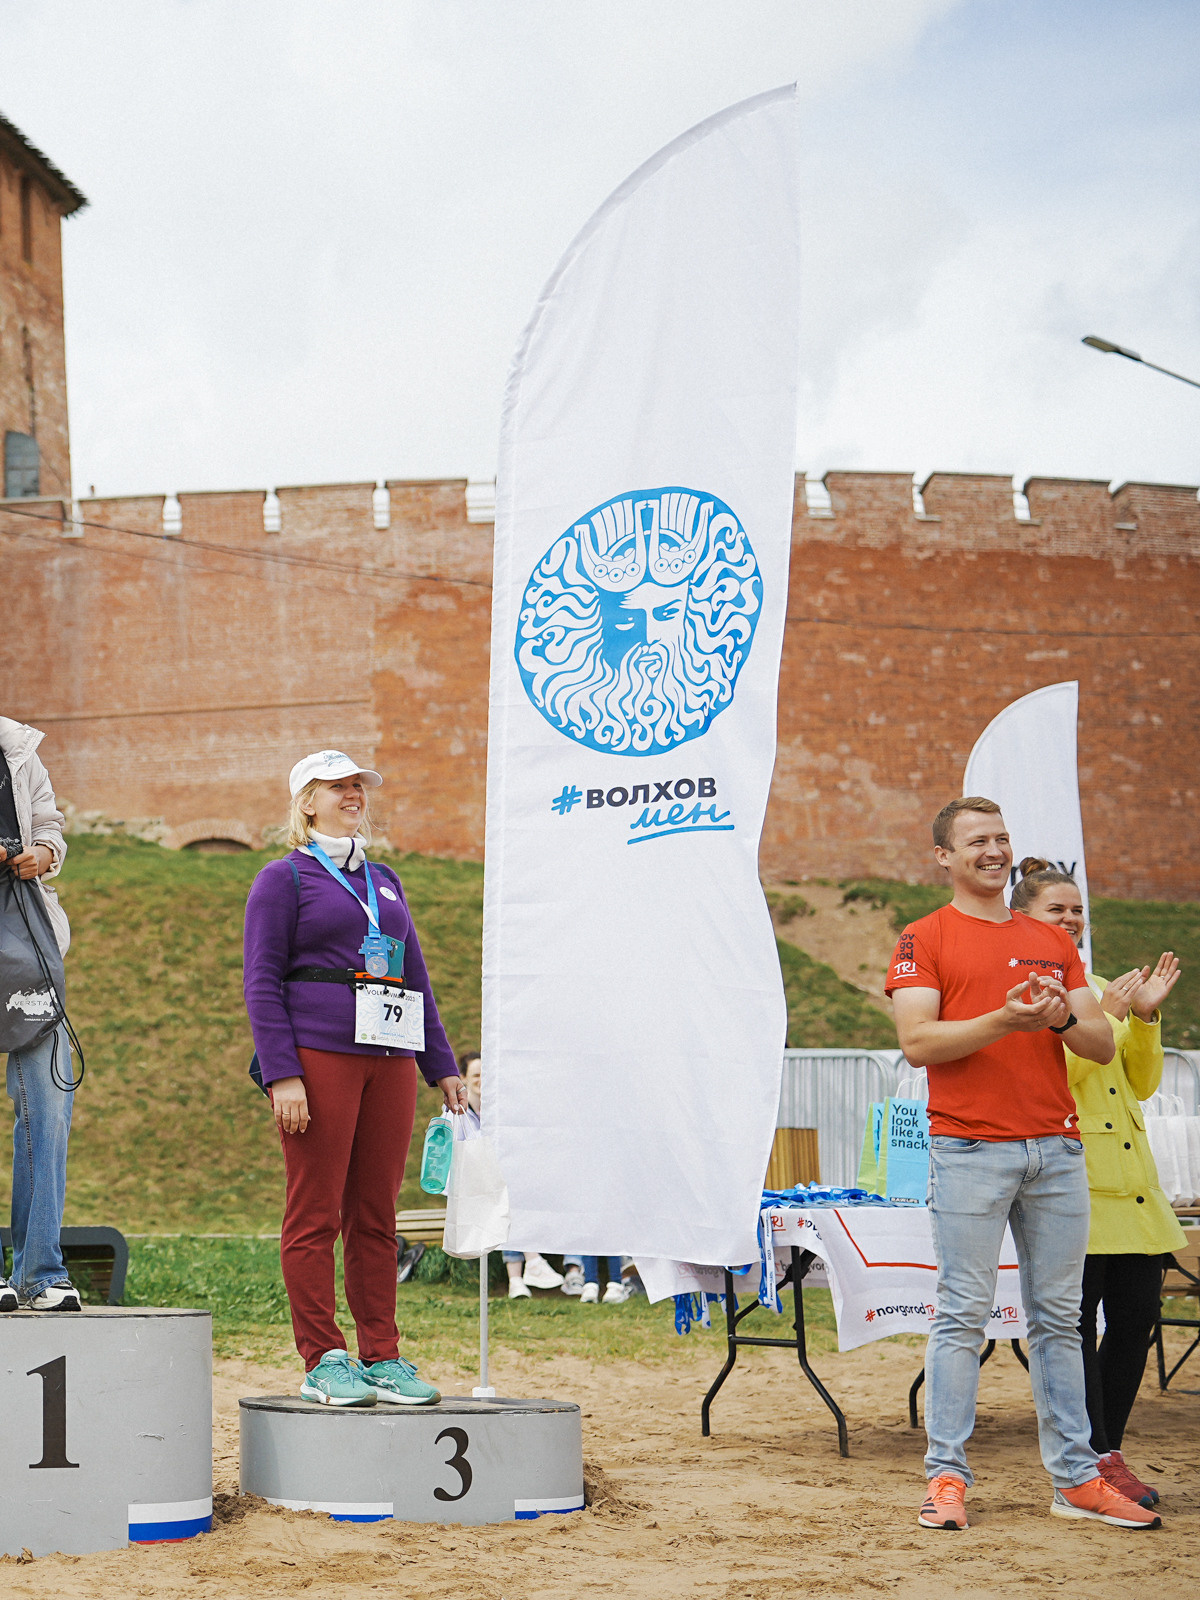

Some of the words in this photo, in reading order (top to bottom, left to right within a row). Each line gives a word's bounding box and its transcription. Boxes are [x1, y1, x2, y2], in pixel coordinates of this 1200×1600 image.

[551, 777, 717, 816] #ВОЛХОВ
[895, 948, 914, 961] rod
[383, 1003, 403, 1023] 79
[892, 1103, 917, 1117] You
[892, 1114, 919, 1128] look
[891, 1125, 914, 1138] like
[916, 1130, 924, 1139] a
[891, 1138, 929, 1151] snack
[26, 1355, 80, 1469] 1
[433, 1426, 473, 1502] 3
